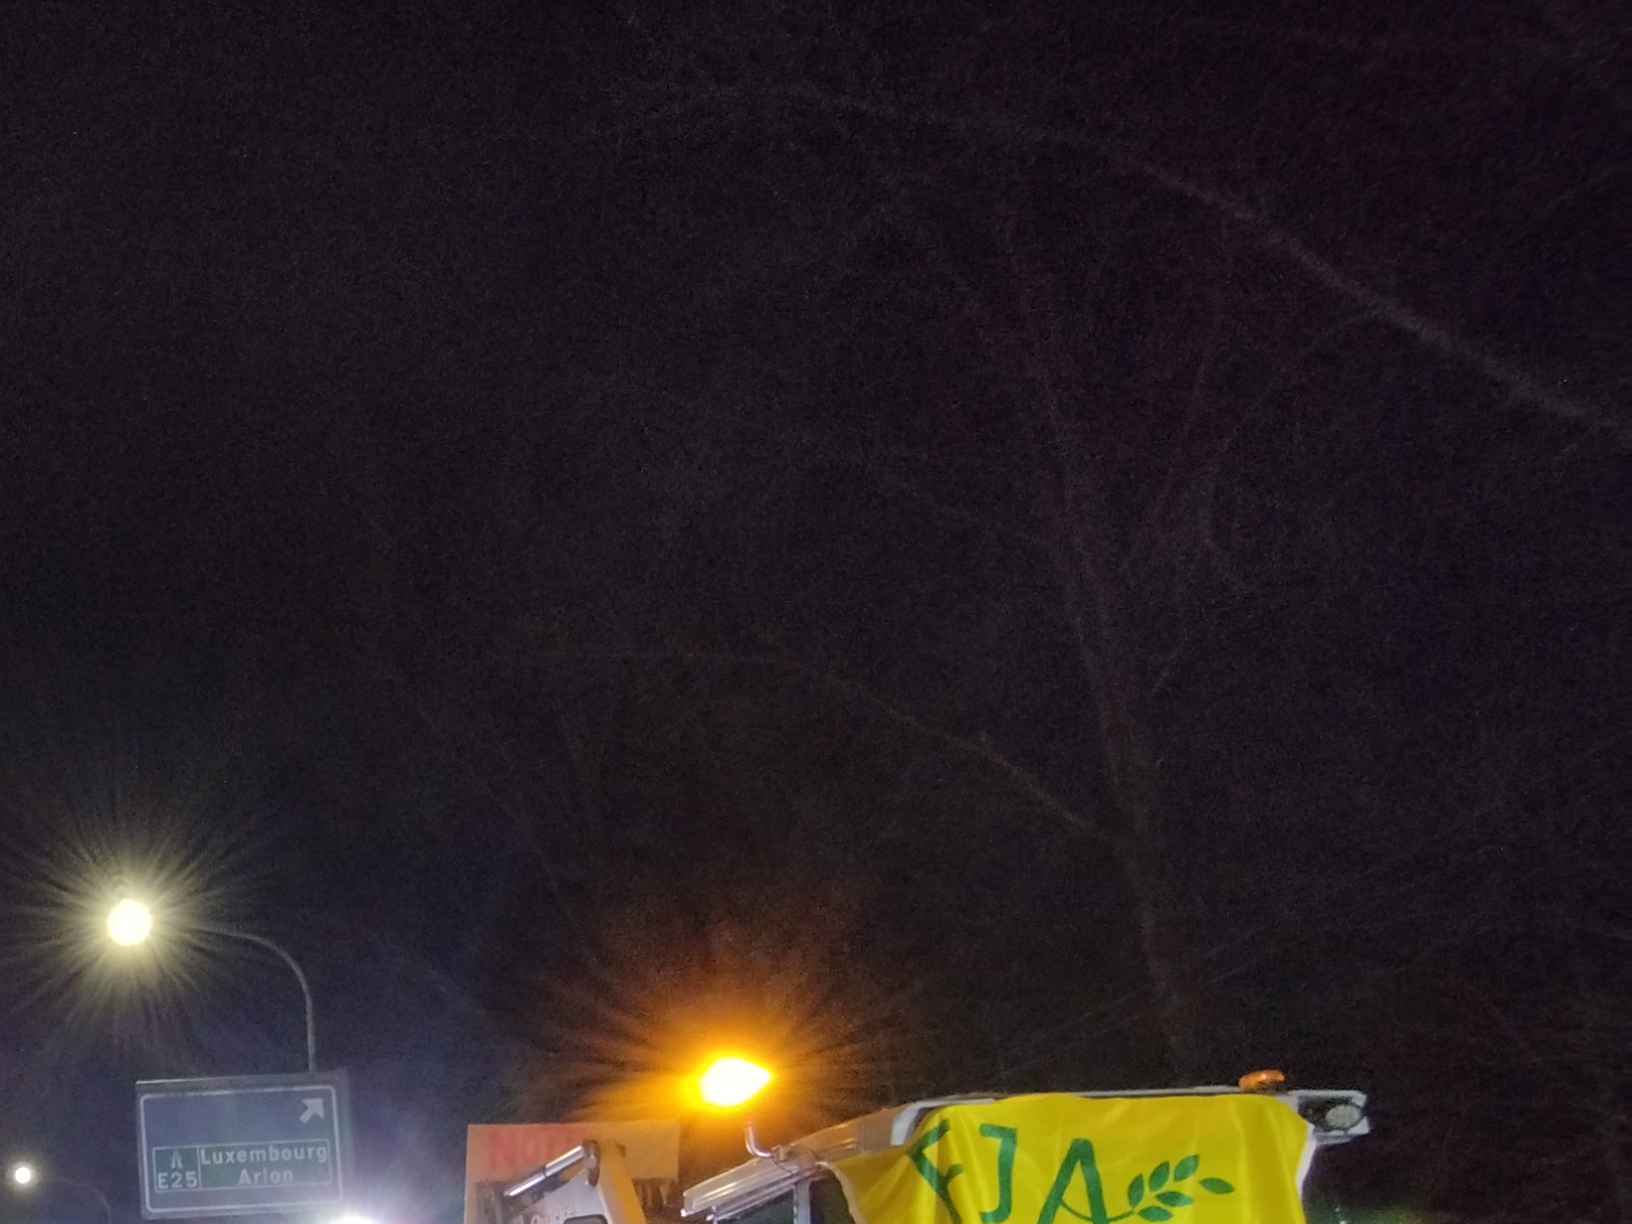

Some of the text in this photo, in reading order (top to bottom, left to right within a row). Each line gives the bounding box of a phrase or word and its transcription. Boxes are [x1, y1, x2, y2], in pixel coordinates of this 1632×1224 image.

[200, 1144, 328, 1165] Luxembourg
[157, 1171, 198, 1190] E25
[238, 1167, 294, 1186] Arlon
